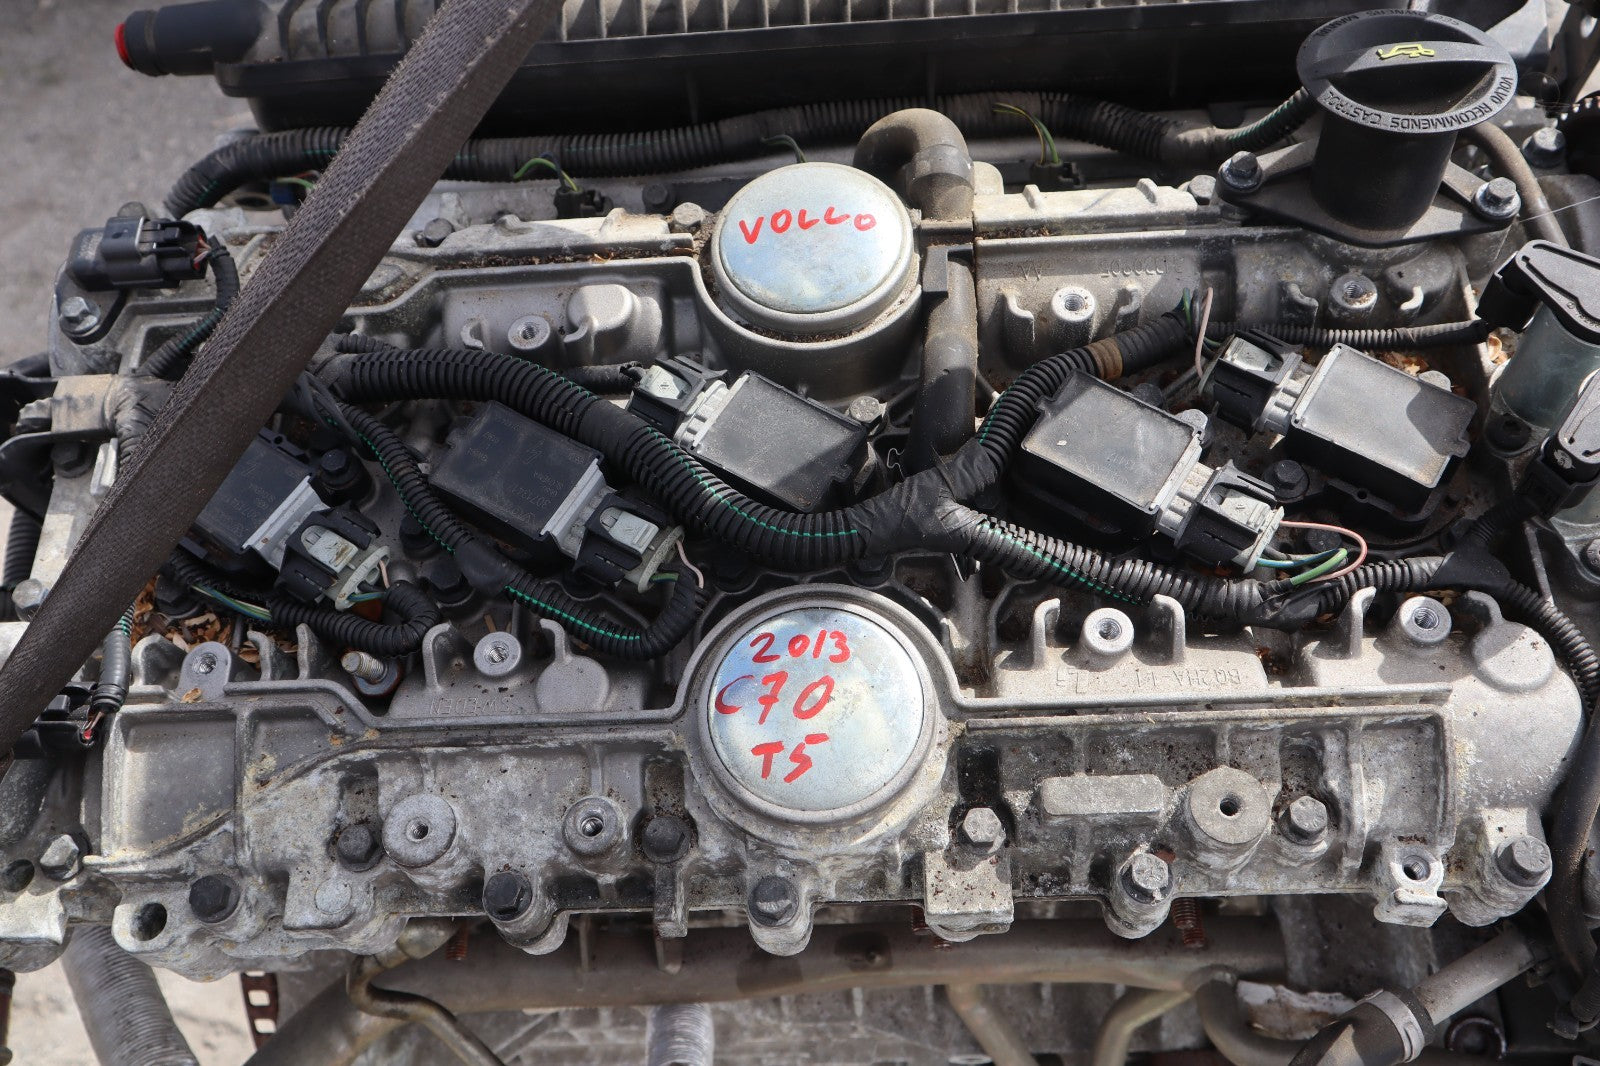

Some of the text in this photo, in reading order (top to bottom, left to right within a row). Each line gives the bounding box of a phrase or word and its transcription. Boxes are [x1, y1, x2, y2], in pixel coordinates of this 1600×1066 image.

[1323, 76, 1514, 131] VOLVO RECOMMENDS CASTROL
[749, 629, 851, 664] 2013
[714, 670, 835, 725] C70
[750, 732, 830, 784] T5
